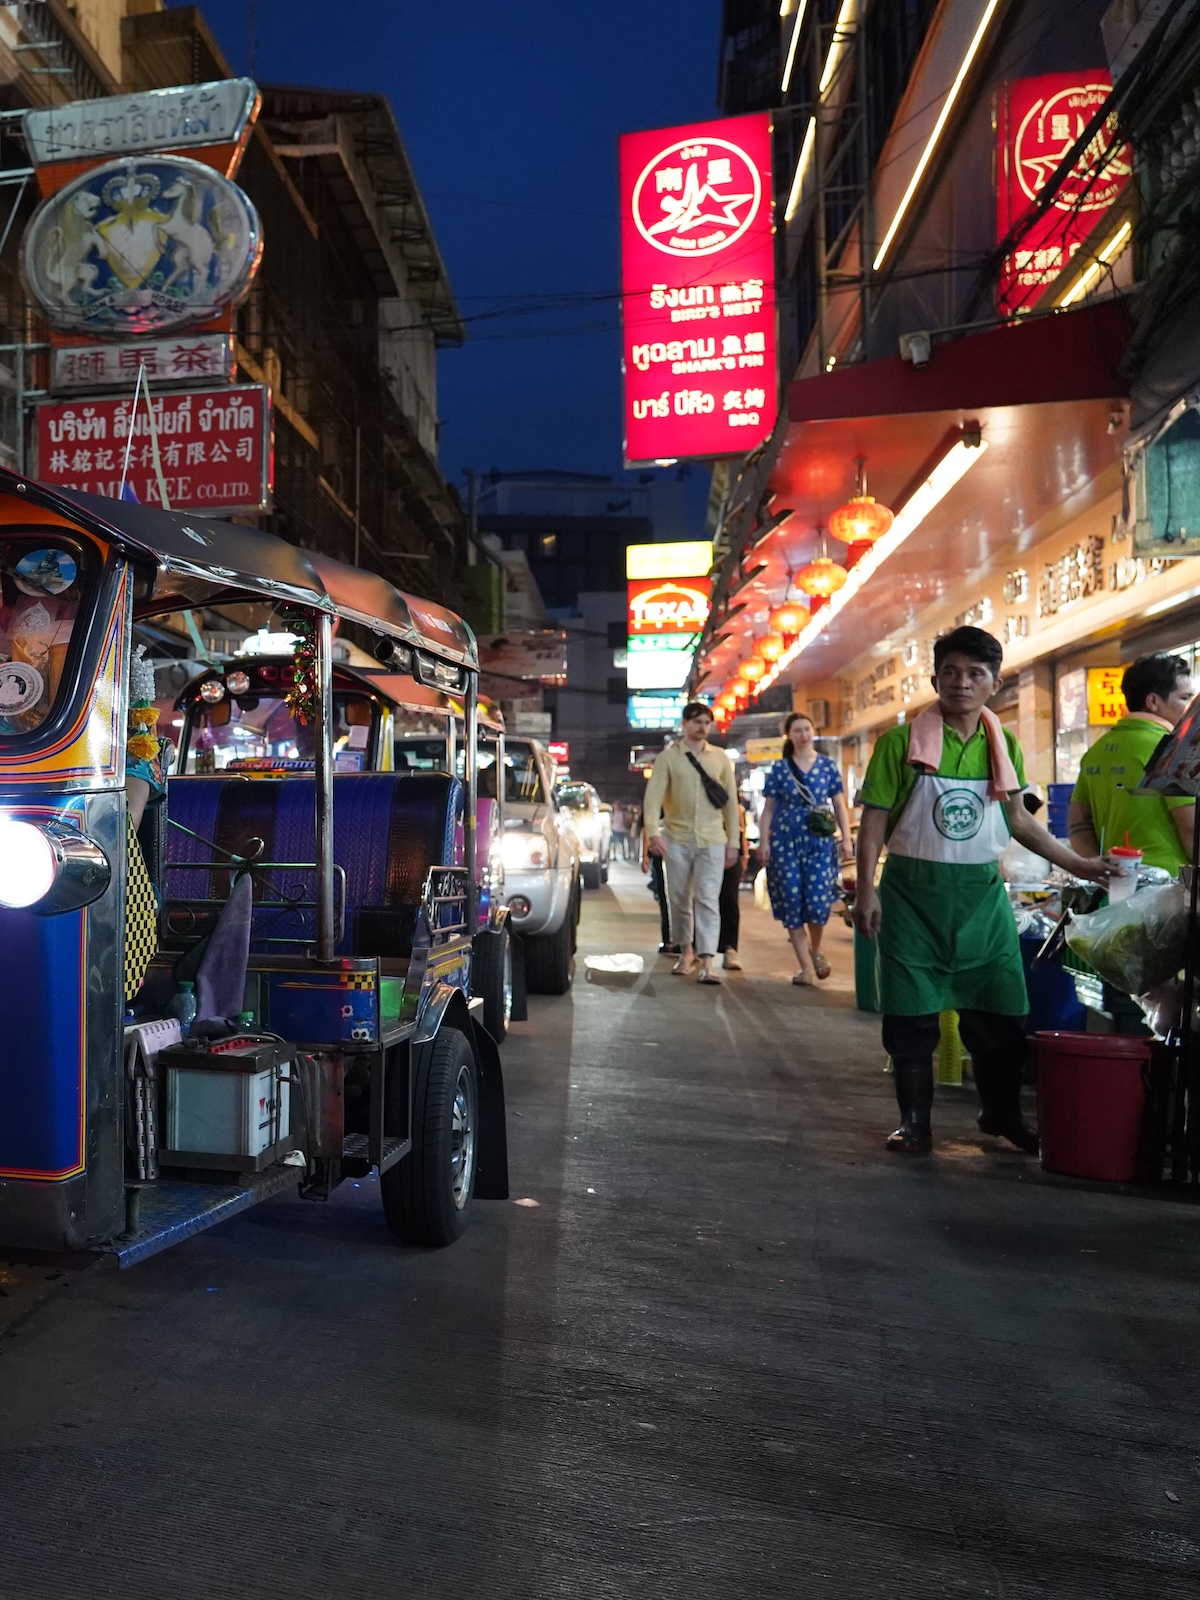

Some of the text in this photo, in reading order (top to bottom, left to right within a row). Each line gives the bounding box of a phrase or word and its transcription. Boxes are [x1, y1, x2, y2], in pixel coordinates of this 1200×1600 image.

[650, 284, 714, 309] รังนก
[723, 301, 762, 317] NEST
[632, 337, 715, 371] หูฉลาม
[672, 353, 764, 375] SHARK'S FIN
[633, 391, 670, 419] บาร์
[48, 407, 107, 443] บริษัท
[199, 397, 255, 432] จำกัด
[728, 413, 760, 427] BBQ
[49, 437, 254, 474] 林銘記茶行有限公司
[145, 476, 192, 502] KEE
[629, 600, 710, 621] TEXAS
